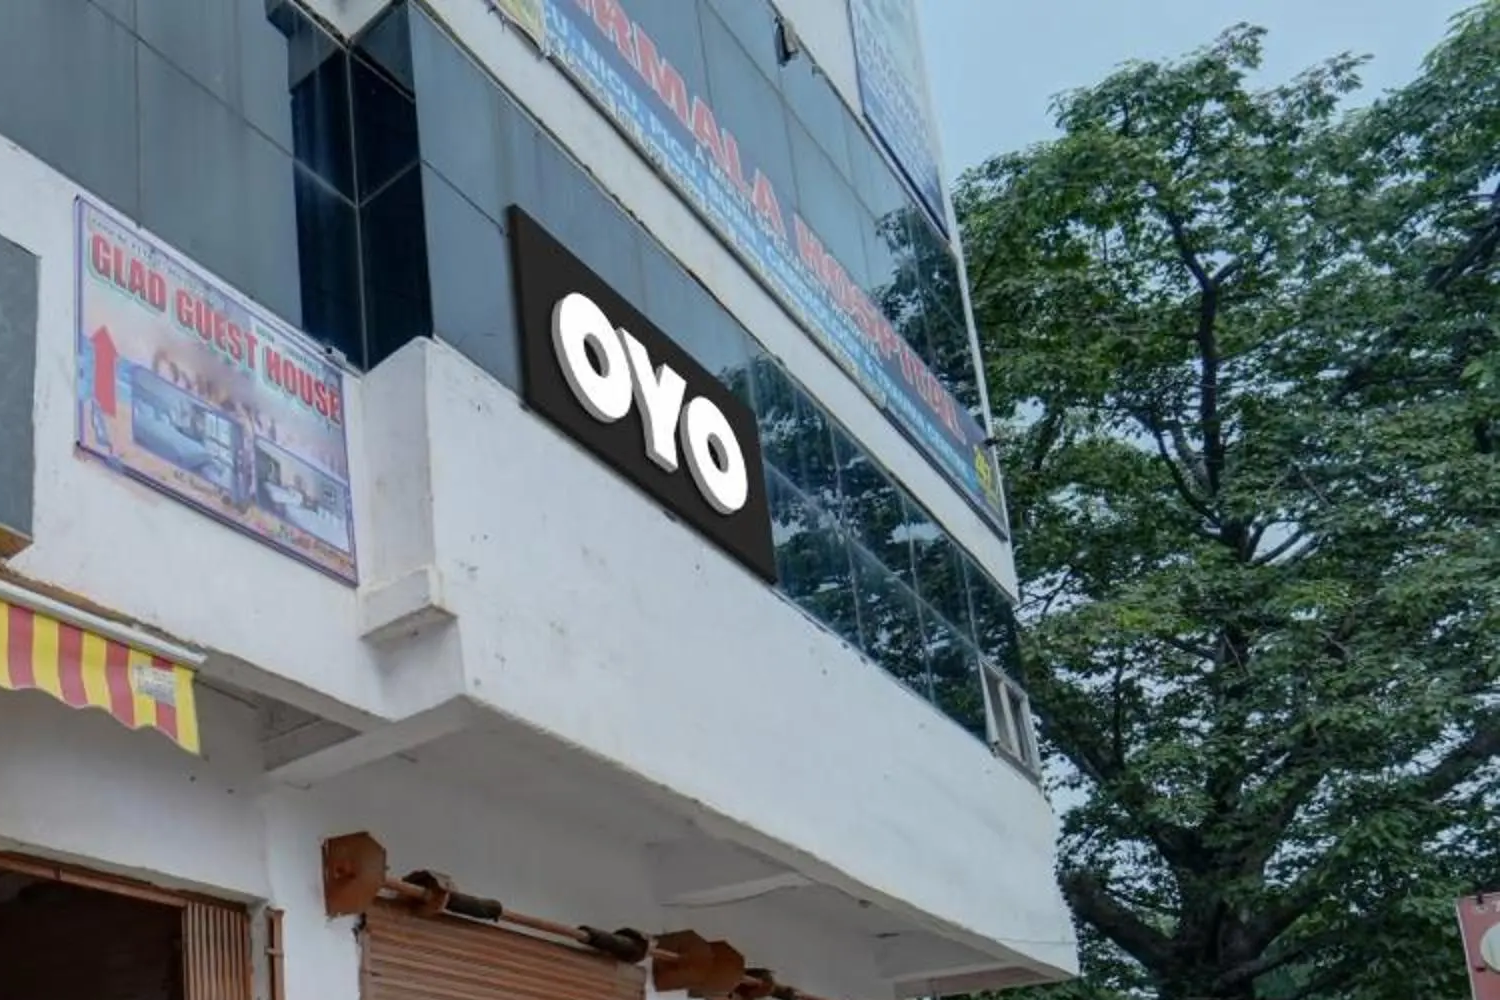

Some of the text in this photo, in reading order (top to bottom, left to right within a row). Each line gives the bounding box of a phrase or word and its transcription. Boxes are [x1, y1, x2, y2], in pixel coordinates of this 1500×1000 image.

[576, 0, 788, 241] RMALA
[91, 232, 167, 313] GLAD
[176, 288, 258, 368] GUEST
[265, 345, 341, 424] HOUSE
[552, 293, 749, 515] OYO
